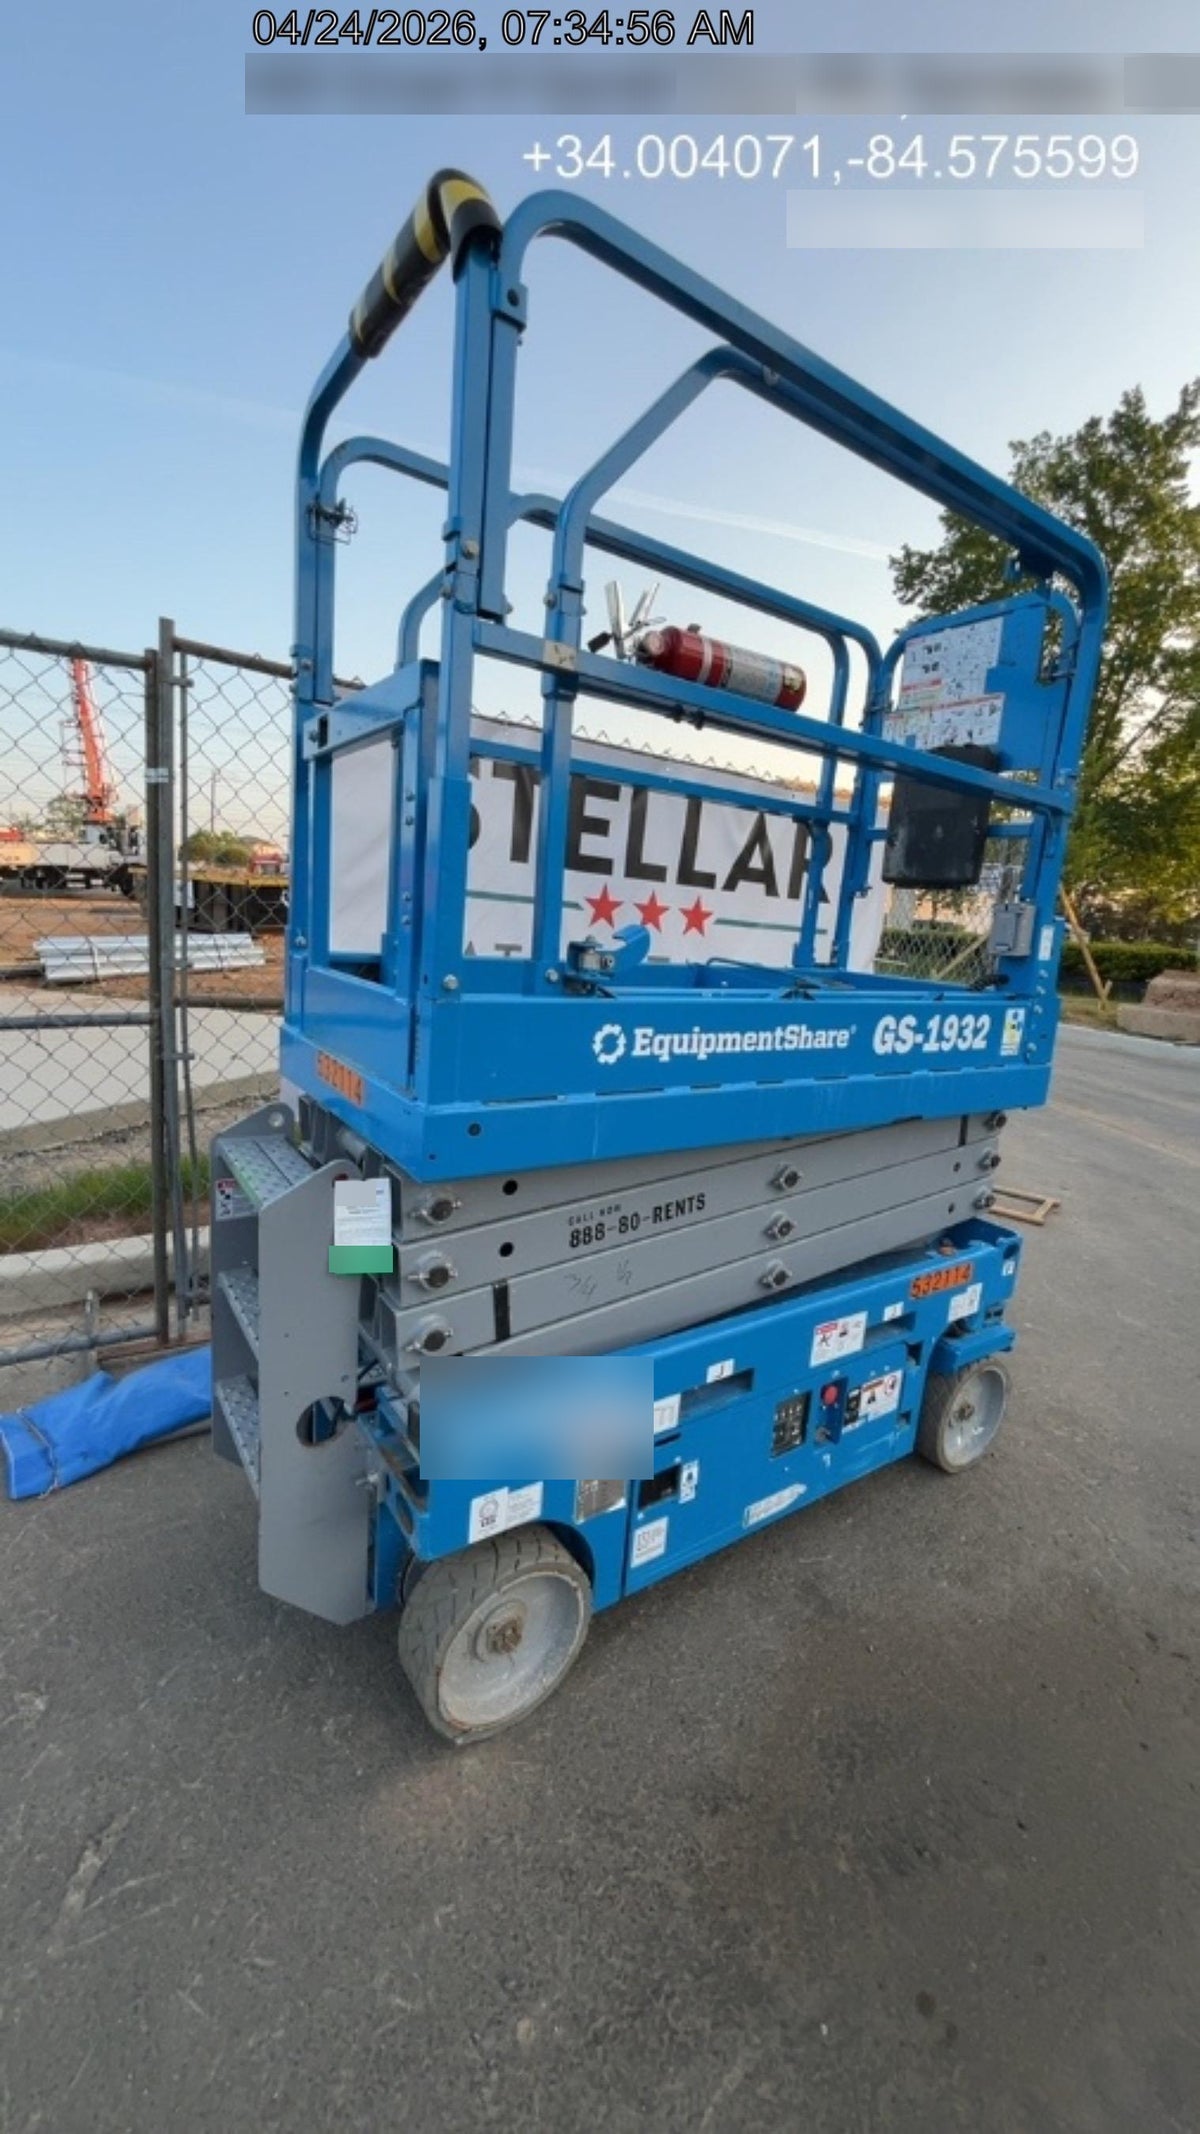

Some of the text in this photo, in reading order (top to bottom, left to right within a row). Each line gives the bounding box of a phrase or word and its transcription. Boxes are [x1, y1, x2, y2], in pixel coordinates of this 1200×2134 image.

[631, 1023, 850, 1063] EquipmentShare
[872, 1013, 991, 1056] GS-1932
[569, 1192, 705, 1248] 888-80-RENTS
